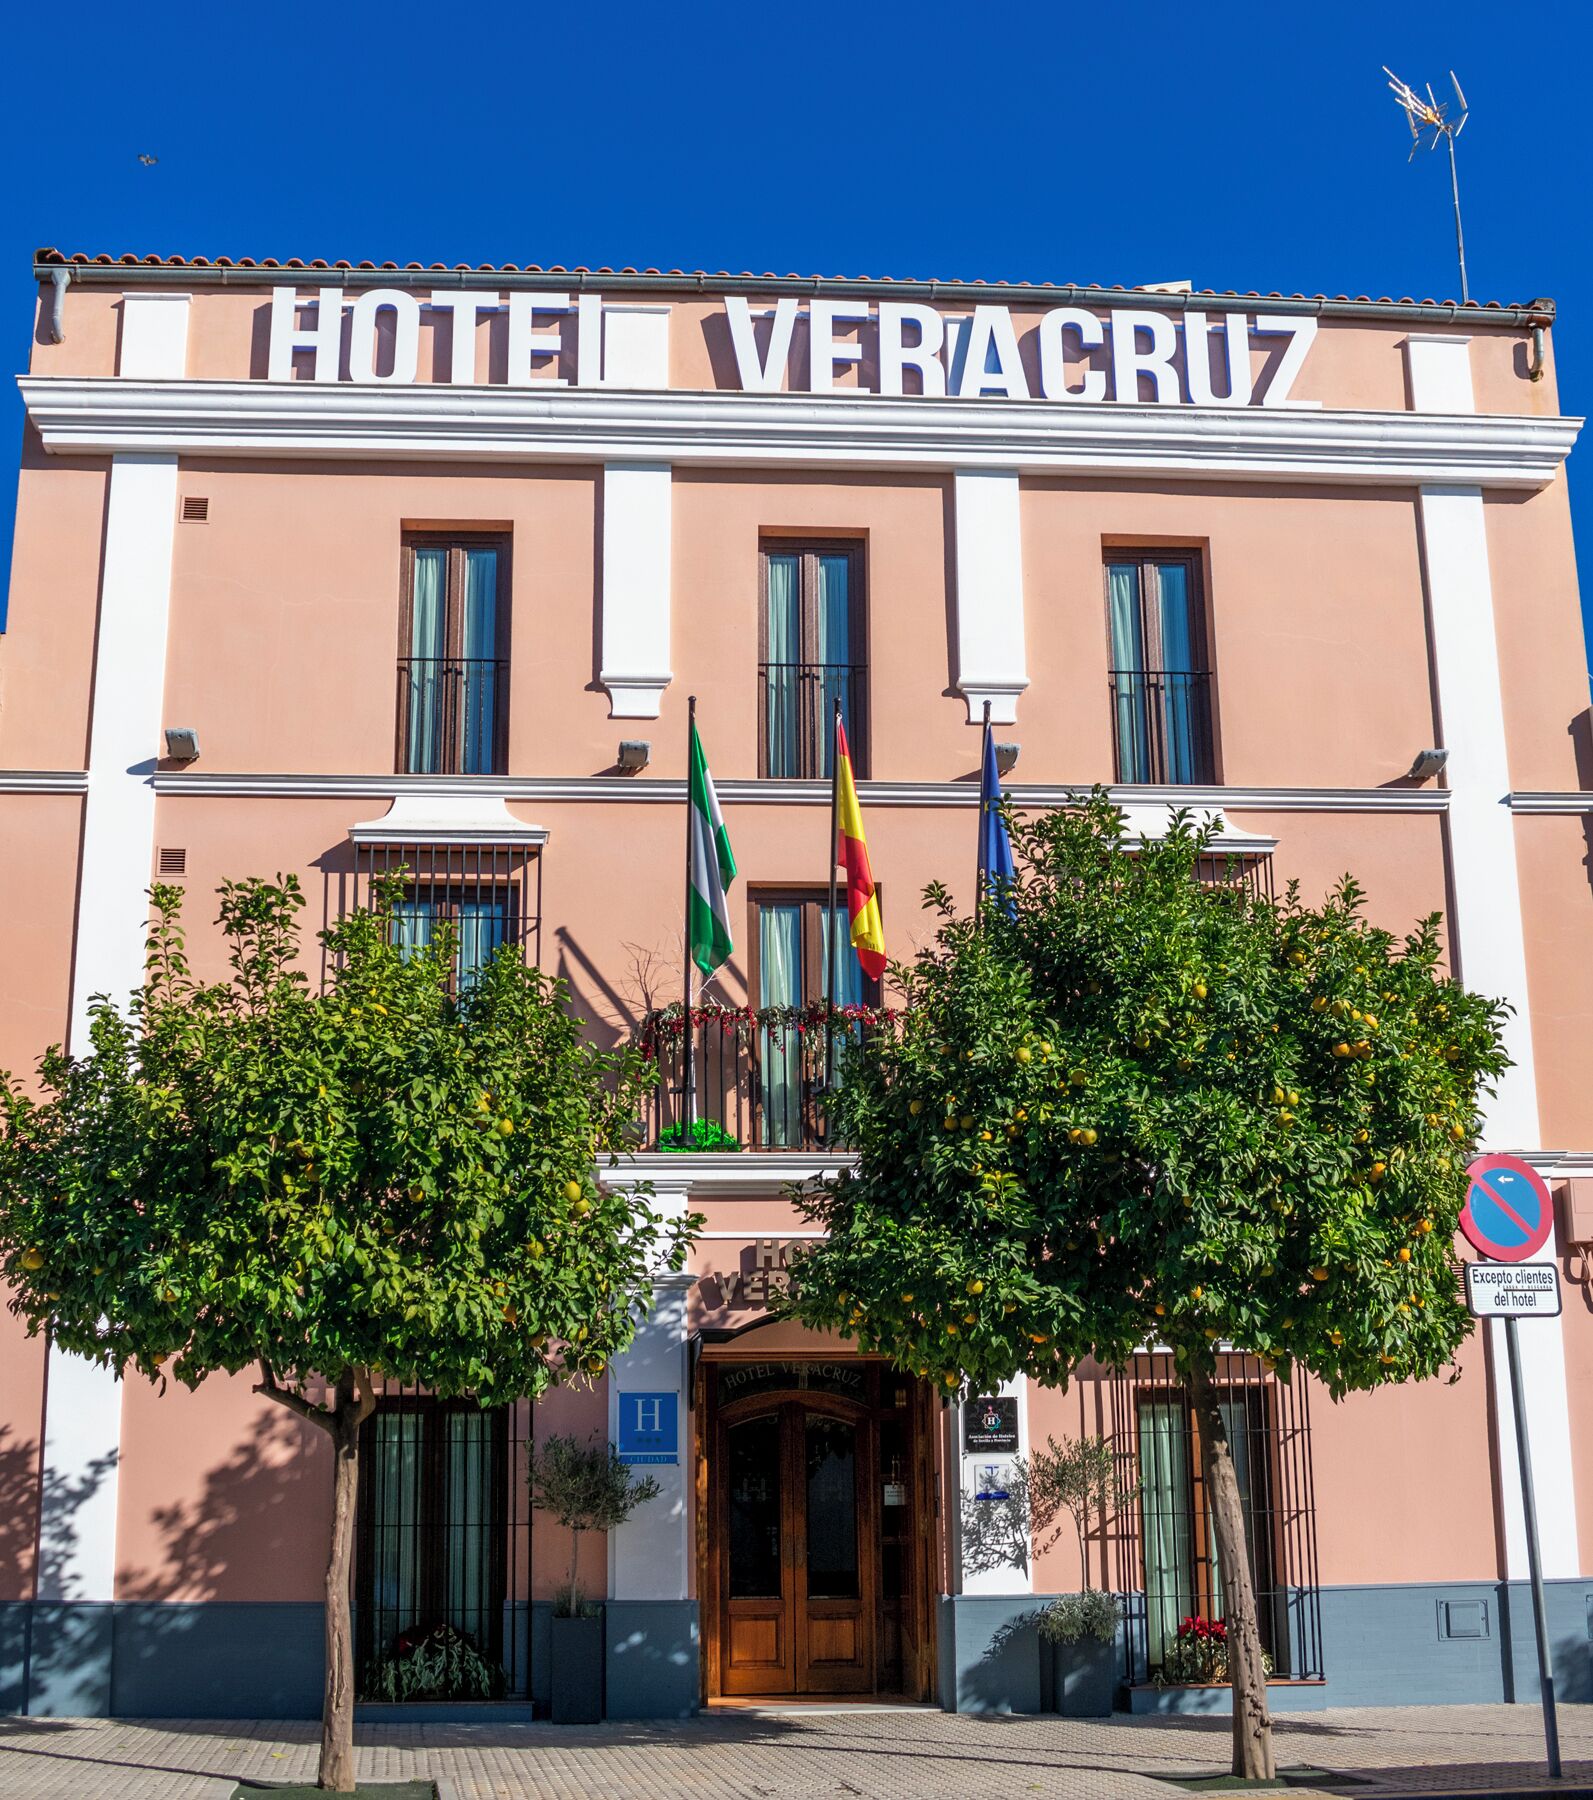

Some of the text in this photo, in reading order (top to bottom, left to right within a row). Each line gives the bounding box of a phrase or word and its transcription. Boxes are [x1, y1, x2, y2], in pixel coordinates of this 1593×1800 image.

[268, 286, 1323, 410] HOTEL VERACRUZ
[756, 1239, 827, 1268] HO
[714, 1271, 801, 1300] VER
[1472, 1269, 1553, 1287] Excepto clientes
[1494, 1291, 1537, 1306] del hotel
[725, 1361, 862, 1389] HOTEL VERACRUZ
[634, 1398, 663, 1431] H
[988, 1416, 996, 1424] H
[630, 1455, 667, 1463] CIUDAD
